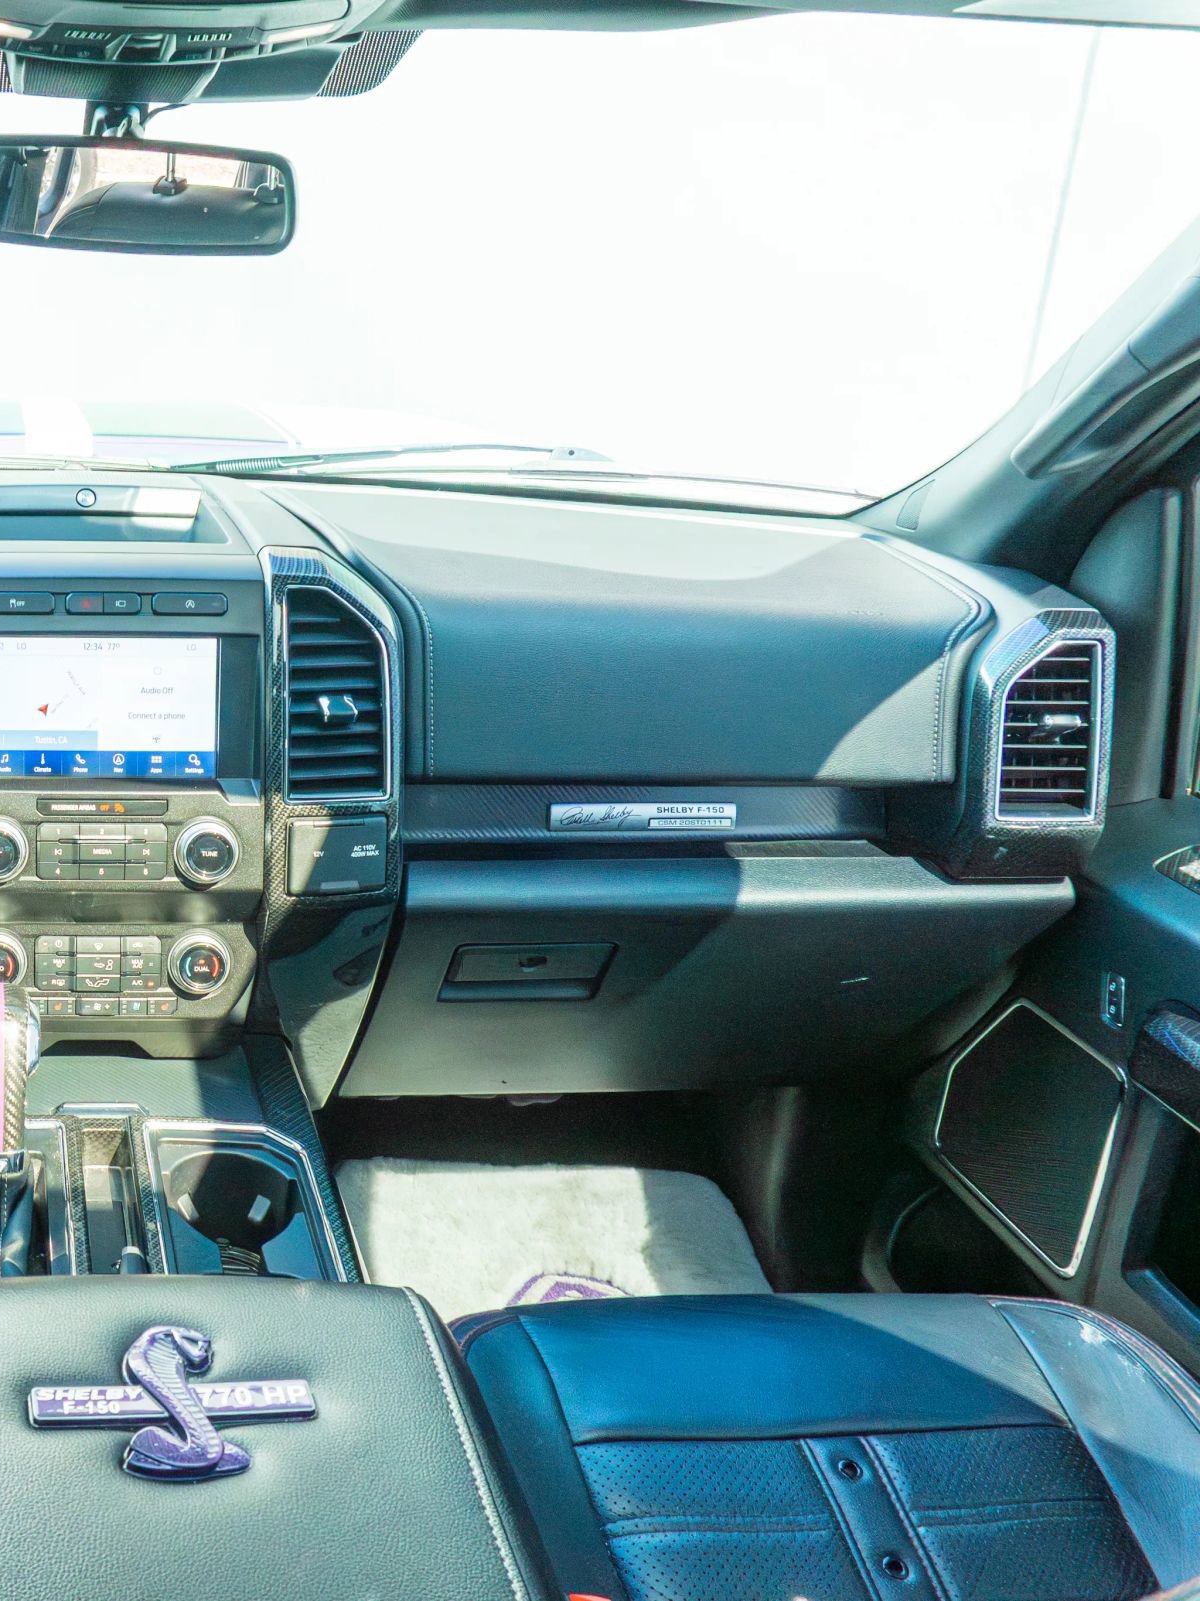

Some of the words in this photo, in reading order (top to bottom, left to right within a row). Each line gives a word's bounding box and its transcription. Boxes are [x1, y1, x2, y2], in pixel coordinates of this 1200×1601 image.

[82, 642, 103, 651] 12:34
[140, 686, 161, 695] Audio
[161, 686, 174, 695] Off
[127, 711, 155, 720] Connect
[162, 711, 186, 722] phone
[150, 766, 163, 775] Apps
[184, 766, 205, 775] Settings
[656, 806, 694, 814] SHELBY
[697, 806, 725, 814] F-150
[201, 850, 218, 858] TUNE
[193, 965, 210, 973] DUAL
[35, 1387, 145, 1401] SHELBY
[197, 1386, 252, 1407] 770
[262, 1384, 308, 1405] HP
[62, 1400, 121, 1414] F-150
